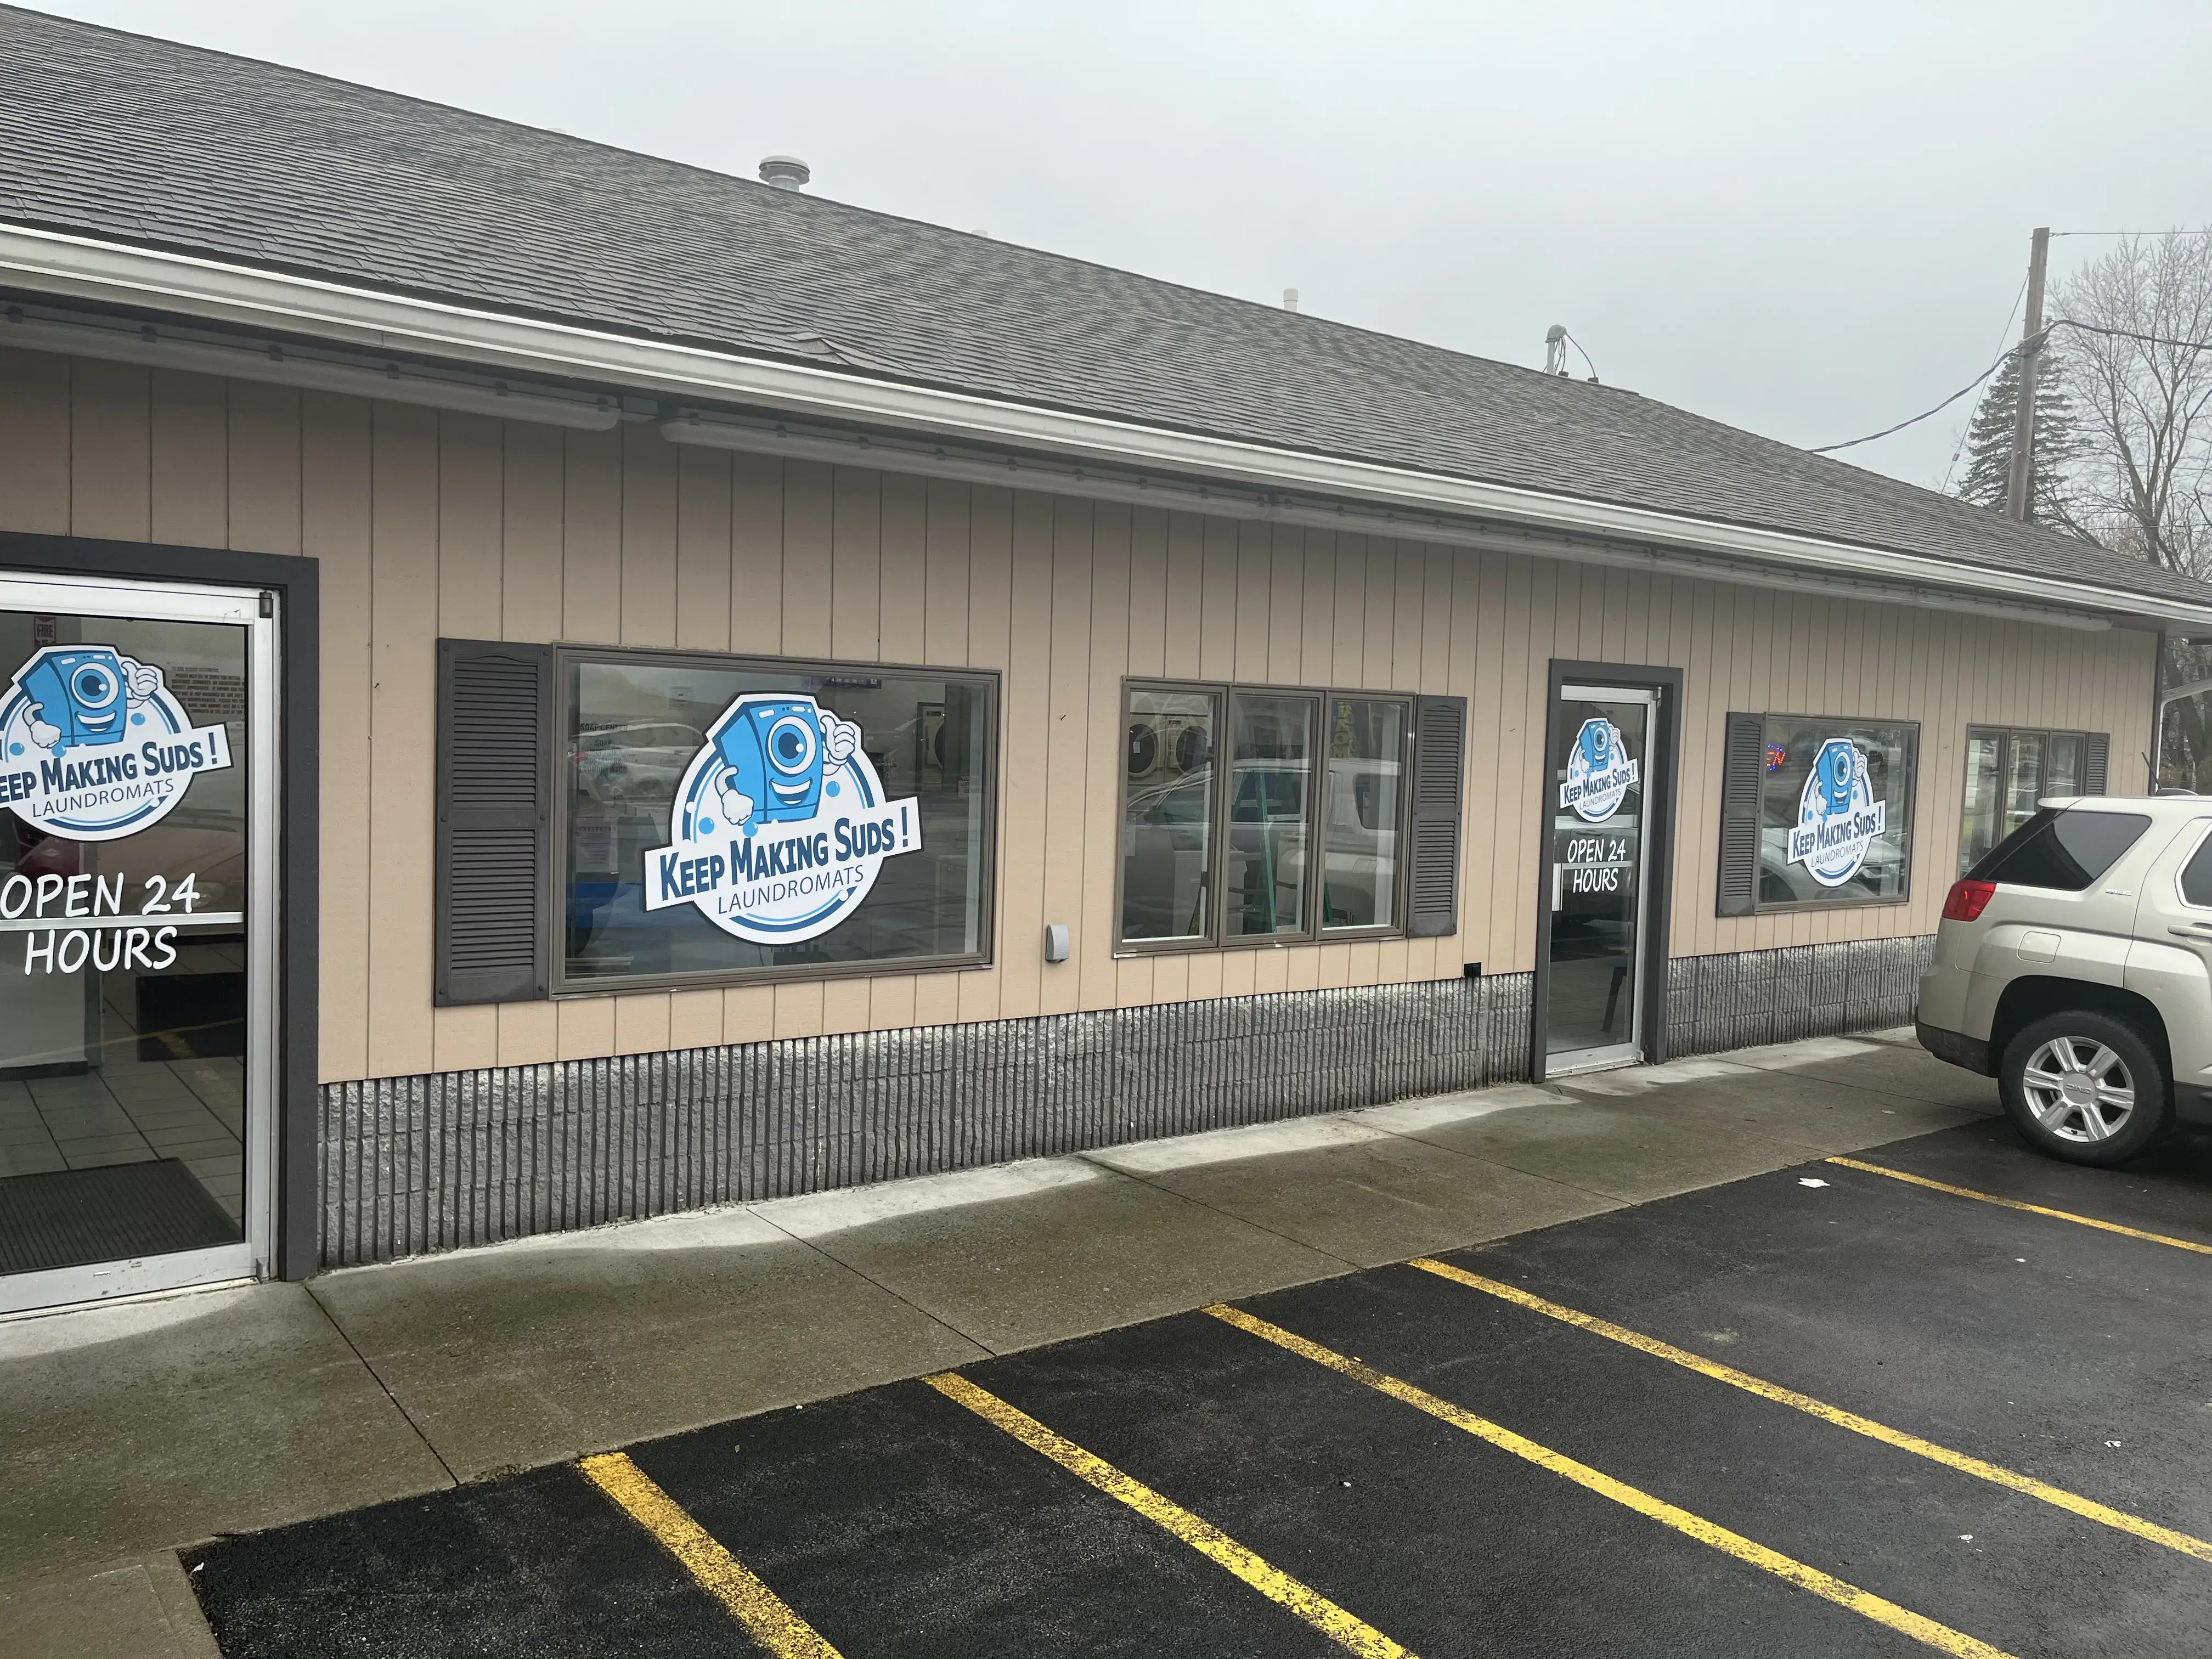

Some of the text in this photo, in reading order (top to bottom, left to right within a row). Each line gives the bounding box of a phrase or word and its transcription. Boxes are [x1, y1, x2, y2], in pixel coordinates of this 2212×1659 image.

[580, 723, 599, 731] SOAP
[0, 772, 37, 804] EEP
[41, 754, 137, 795] MAKING
[33, 779, 174, 818] LAUNDROMATS
[1564, 785, 1582, 805] KEEP
[1583, 775, 1611, 798] MAKING
[1579, 788, 1622, 810] LAUNDROMATS
[1568, 838, 1626, 864] OPEN 24
[1793, 830, 1815, 859] KEEP
[1816, 820, 1852, 851] MAKING
[1811, 840, 1864, 868] LAUNDROMATS
[659, 852, 725, 901] KEEP
[730, 833, 829, 885] MAKING
[1572, 868, 1618, 893] HOURS
[0, 872, 200, 919] OPEN 24
[719, 865, 864, 915] LAUNDROMATS
[25, 926, 178, 975] HOURS
